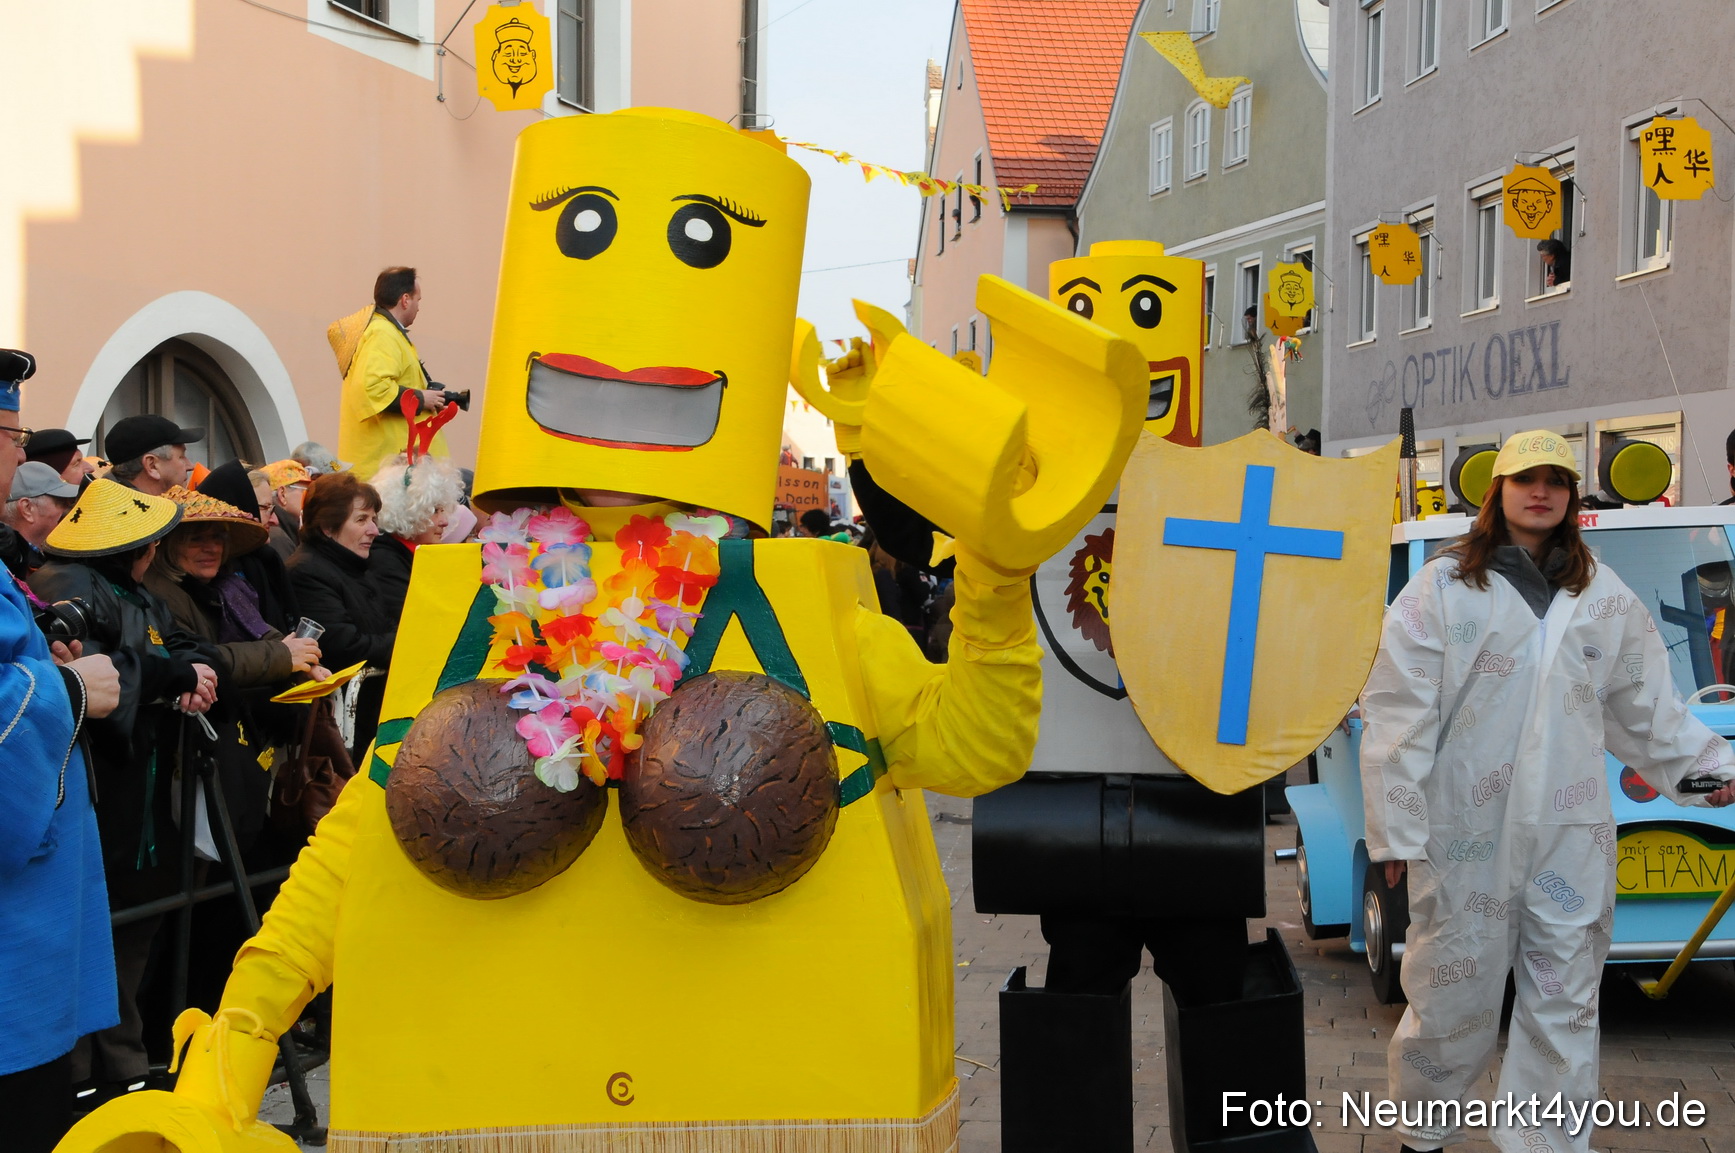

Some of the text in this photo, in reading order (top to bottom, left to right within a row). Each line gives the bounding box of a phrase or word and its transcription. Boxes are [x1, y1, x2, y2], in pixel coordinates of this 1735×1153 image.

[1402, 319, 1571, 408] OPTIK OEXL
[1518, 435, 1568, 458] LEGO
[786, 493, 819, 505] Dach
[1588, 594, 1629, 621] LEGO
[1472, 763, 1514, 808] LEGO
[1554, 777, 1598, 812] LEGO
[1447, 839, 1494, 862] LEGO
[1622, 840, 1688, 855] mir san
[1616, 854, 1735, 891] CHAM
[1464, 891, 1510, 921] LEGO
[1533, 870, 1585, 913] LEGO
[1429, 956, 1477, 989] LEGO
[1526, 951, 1565, 996] LEGO
[1448, 1008, 1495, 1043] LEGO
[1402, 1050, 1453, 1084] LEGO
[1530, 1035, 1571, 1075] LEGO
